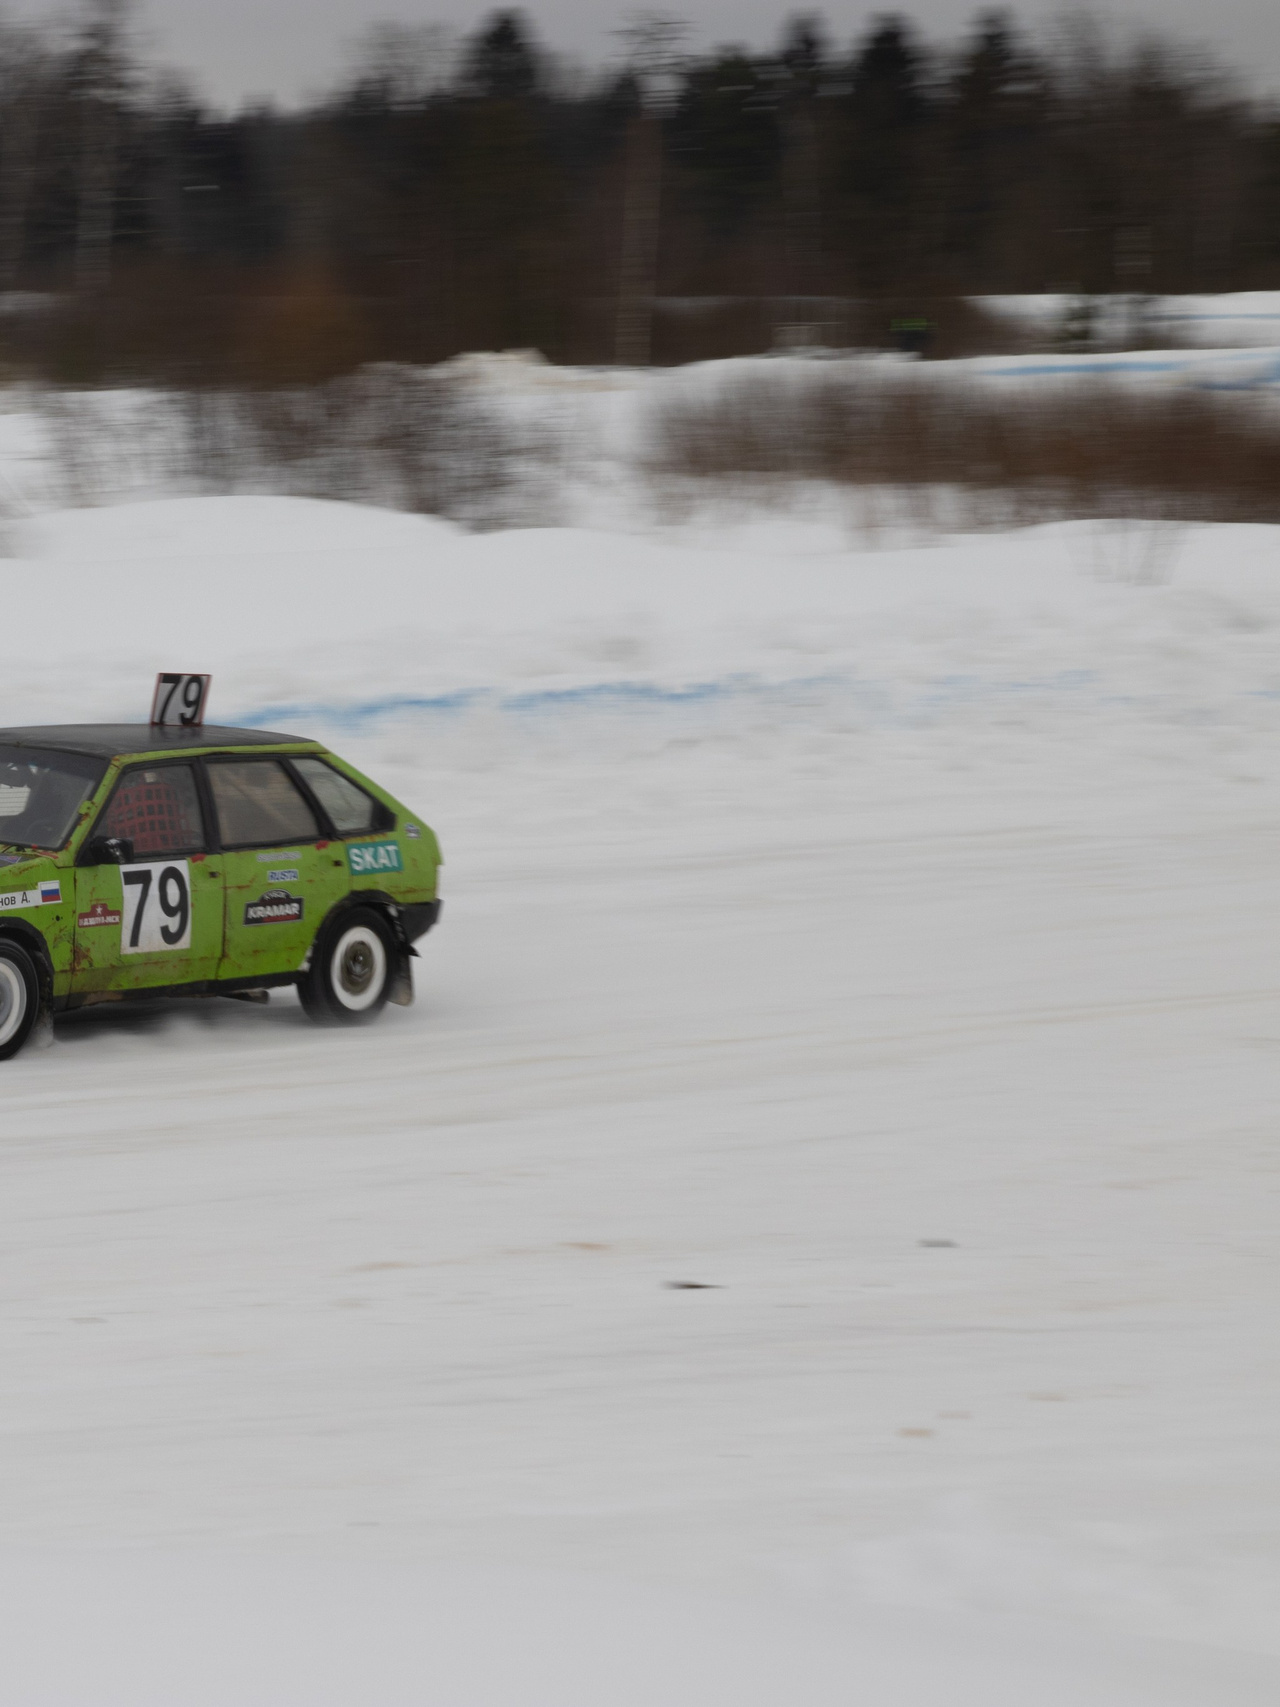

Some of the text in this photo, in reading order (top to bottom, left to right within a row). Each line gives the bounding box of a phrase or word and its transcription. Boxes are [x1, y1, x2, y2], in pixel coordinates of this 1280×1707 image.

[159, 675, 202, 725] 79
[348, 845, 399, 871] SKAT
[122, 866, 189, 947] 79
[247, 903, 300, 919] KRAMAR
